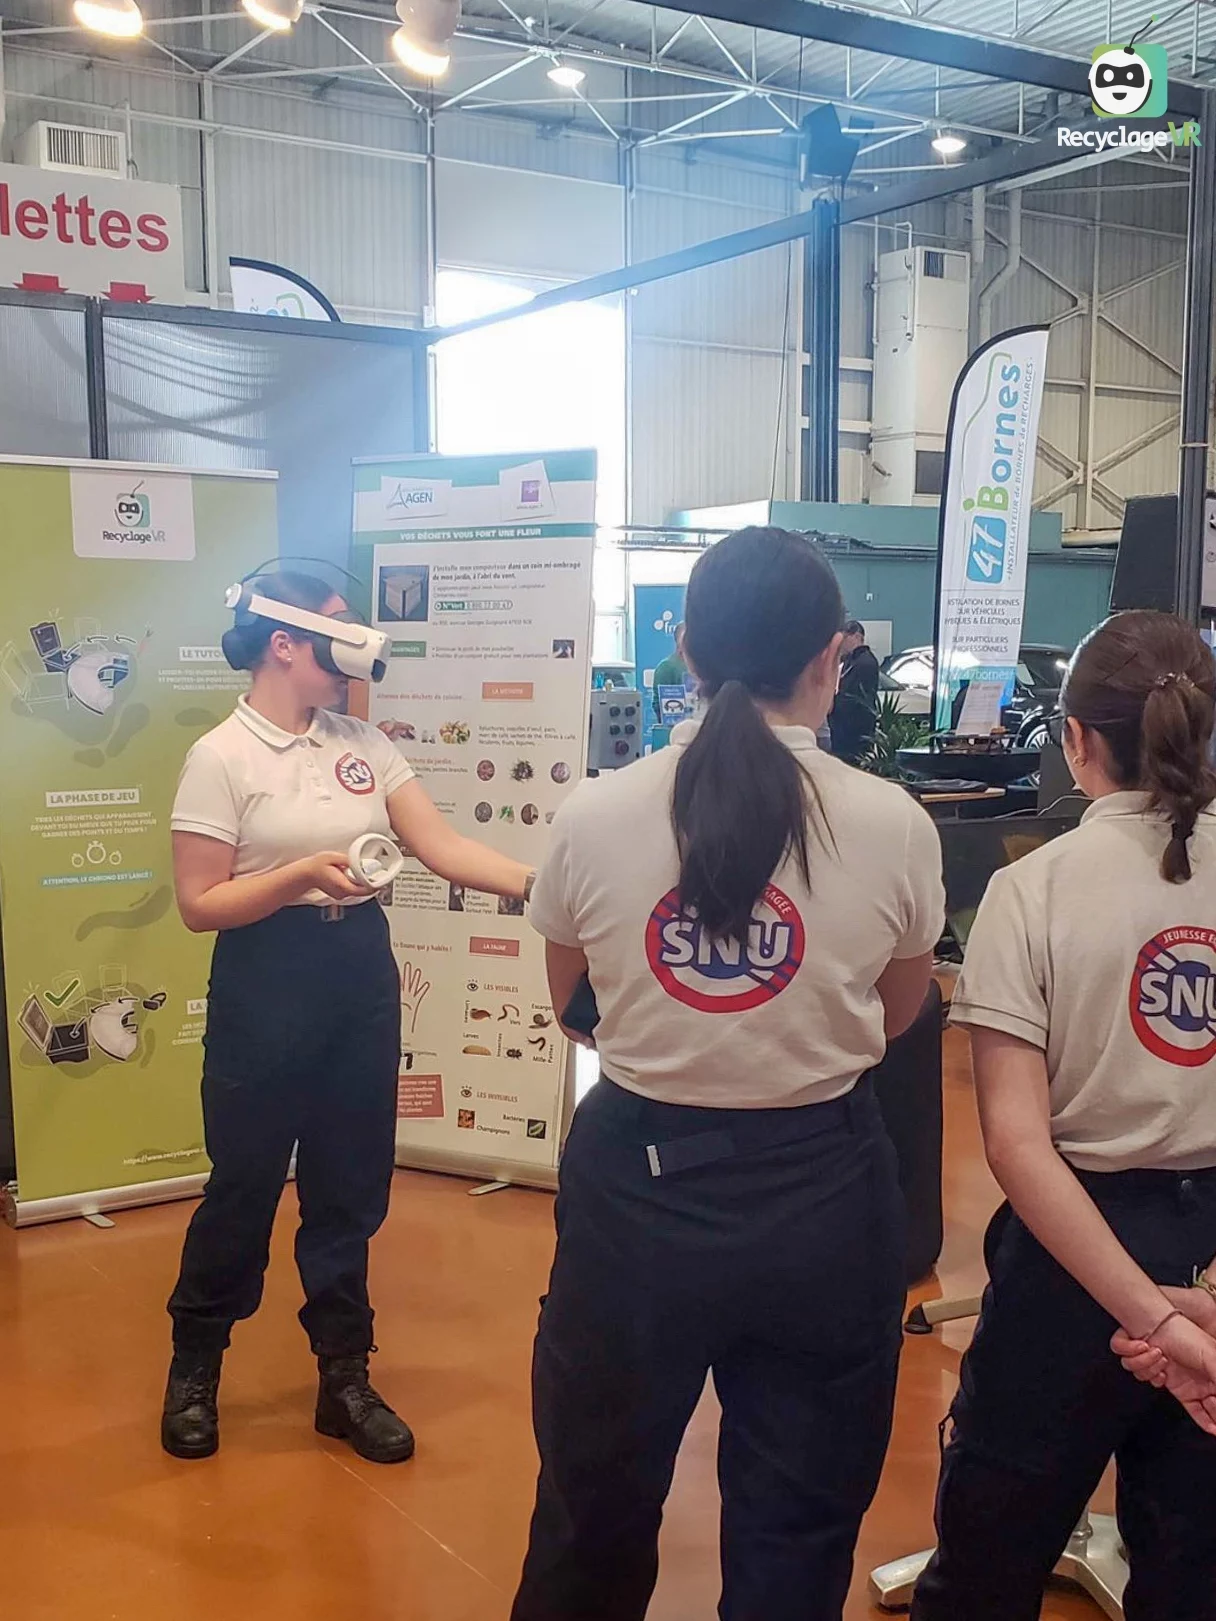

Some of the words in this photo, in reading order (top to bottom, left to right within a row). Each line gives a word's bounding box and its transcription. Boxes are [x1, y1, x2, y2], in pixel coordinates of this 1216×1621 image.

[405, 491, 434, 504] AGEN
[453, 530, 474, 538] VOUS
[475, 529, 497, 537] FONT
[498, 528, 515, 537] UNE
[517, 527, 542, 536] FLEUR
[508, 562, 521, 570] dans
[194, 650, 223, 658] TUTO
[50, 795, 65, 804] LA
[66, 793, 100, 803] PHASE
[101, 792, 115, 801] DE
[116, 791, 135, 801] JEU
[661, 920, 790, 967] SNU
[495, 985, 519, 993] VISIBLES
[477, 1091, 487, 1099] LES
